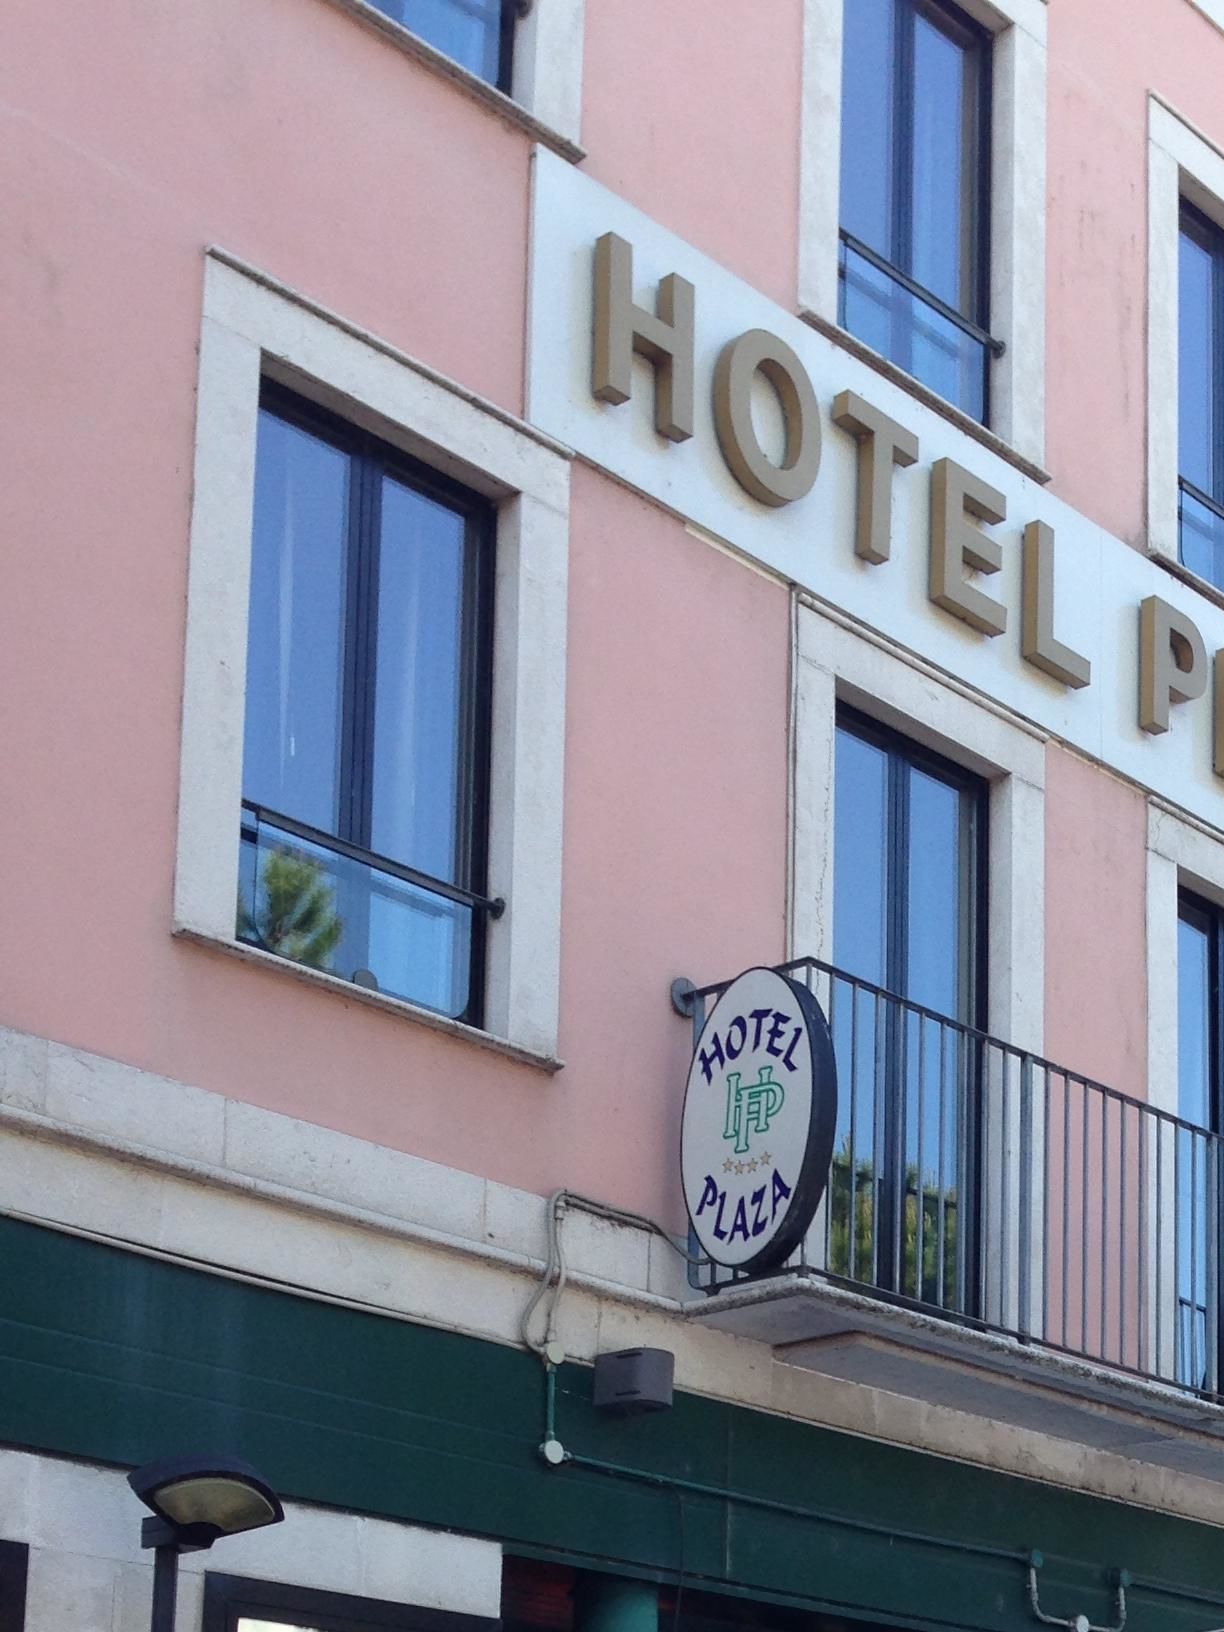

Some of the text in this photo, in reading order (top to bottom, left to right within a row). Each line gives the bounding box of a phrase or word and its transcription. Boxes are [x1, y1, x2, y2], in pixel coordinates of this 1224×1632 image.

[592, 230, 1091, 690] HOTEL
[698, 1007, 803, 1086] HOTEL
[695, 1168, 792, 1246] PLAZA
